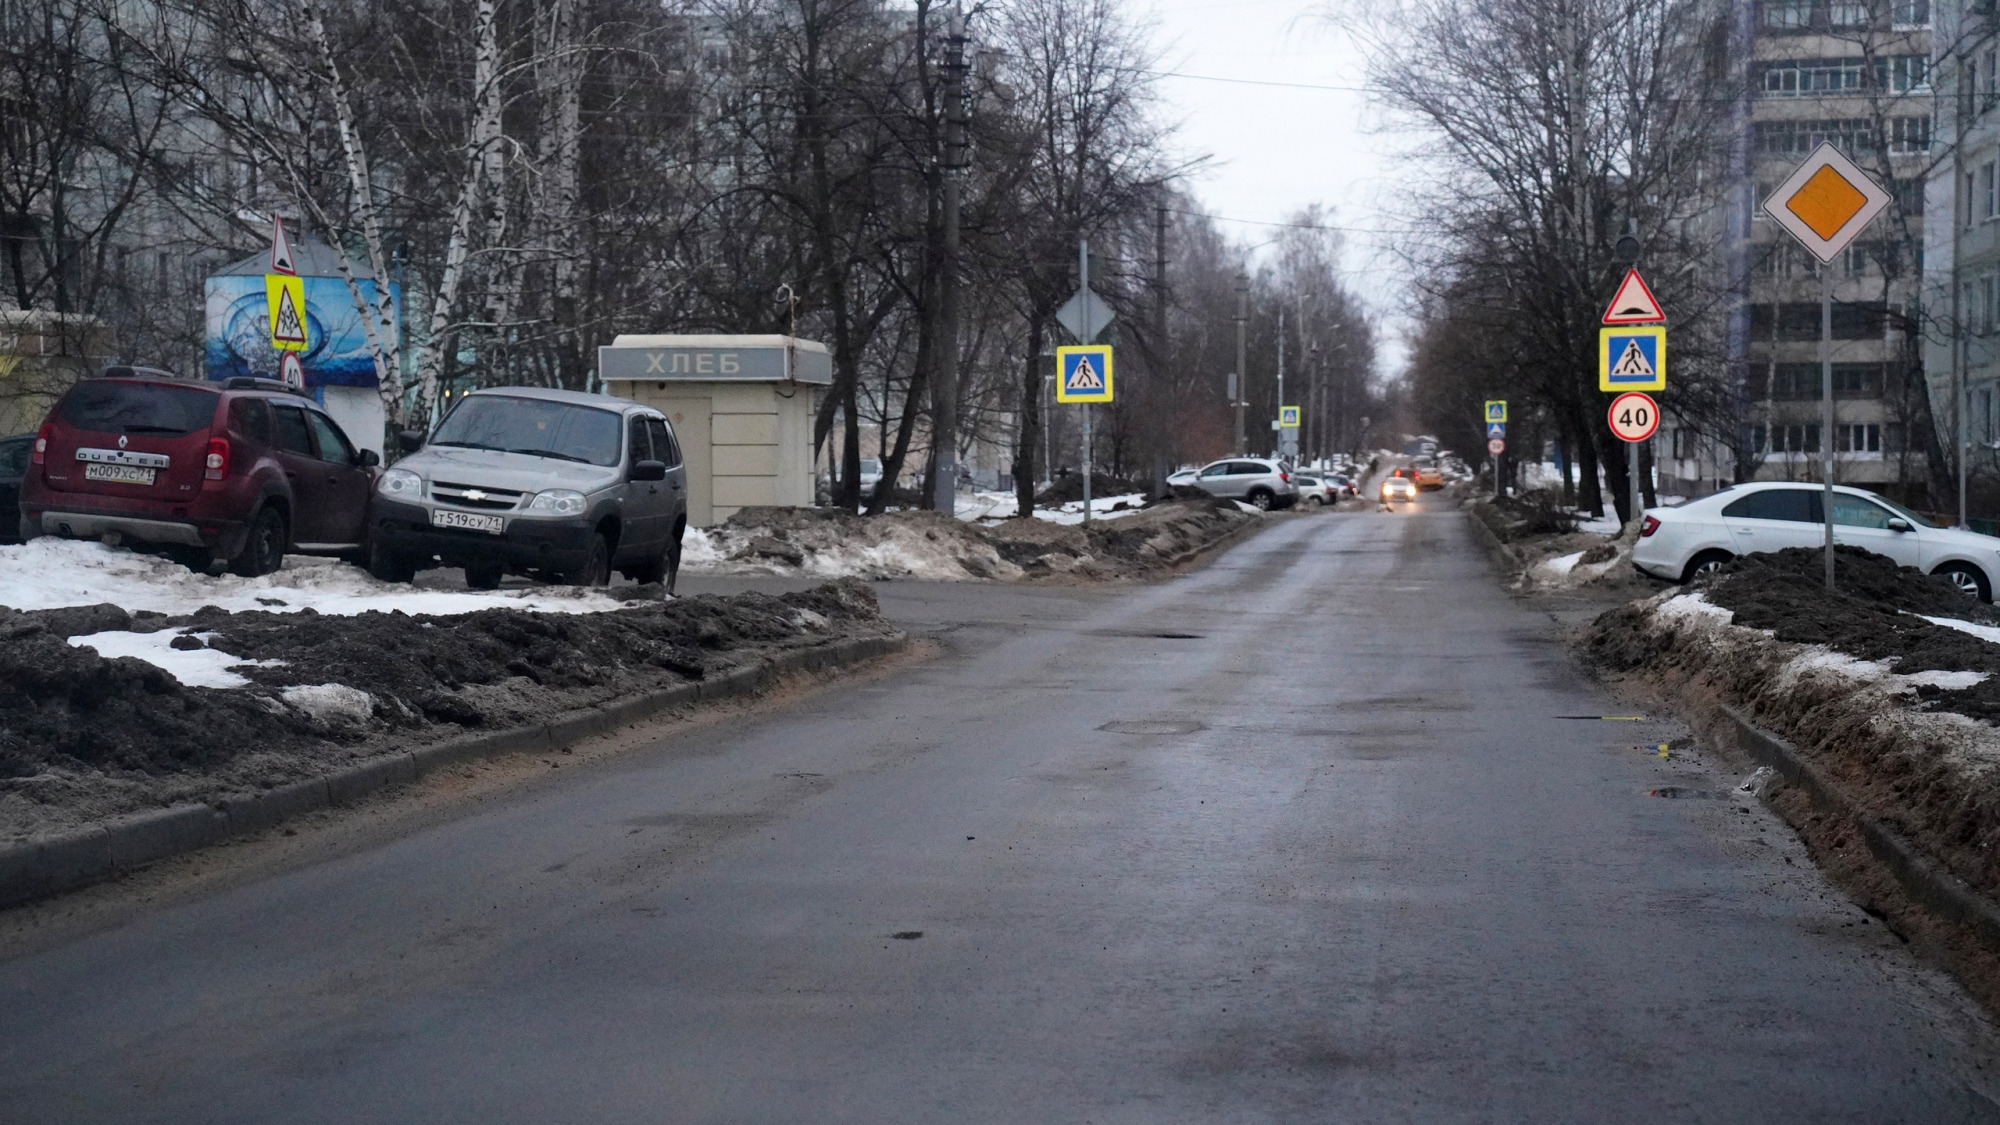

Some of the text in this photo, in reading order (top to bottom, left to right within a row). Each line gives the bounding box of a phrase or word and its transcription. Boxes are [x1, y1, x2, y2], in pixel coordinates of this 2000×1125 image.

[646, 353, 740, 373] ХЛЕБ
[287, 367, 300, 386] 40
[1619, 408, 1648, 427] 40
[78, 452, 164, 465] DUSTER
